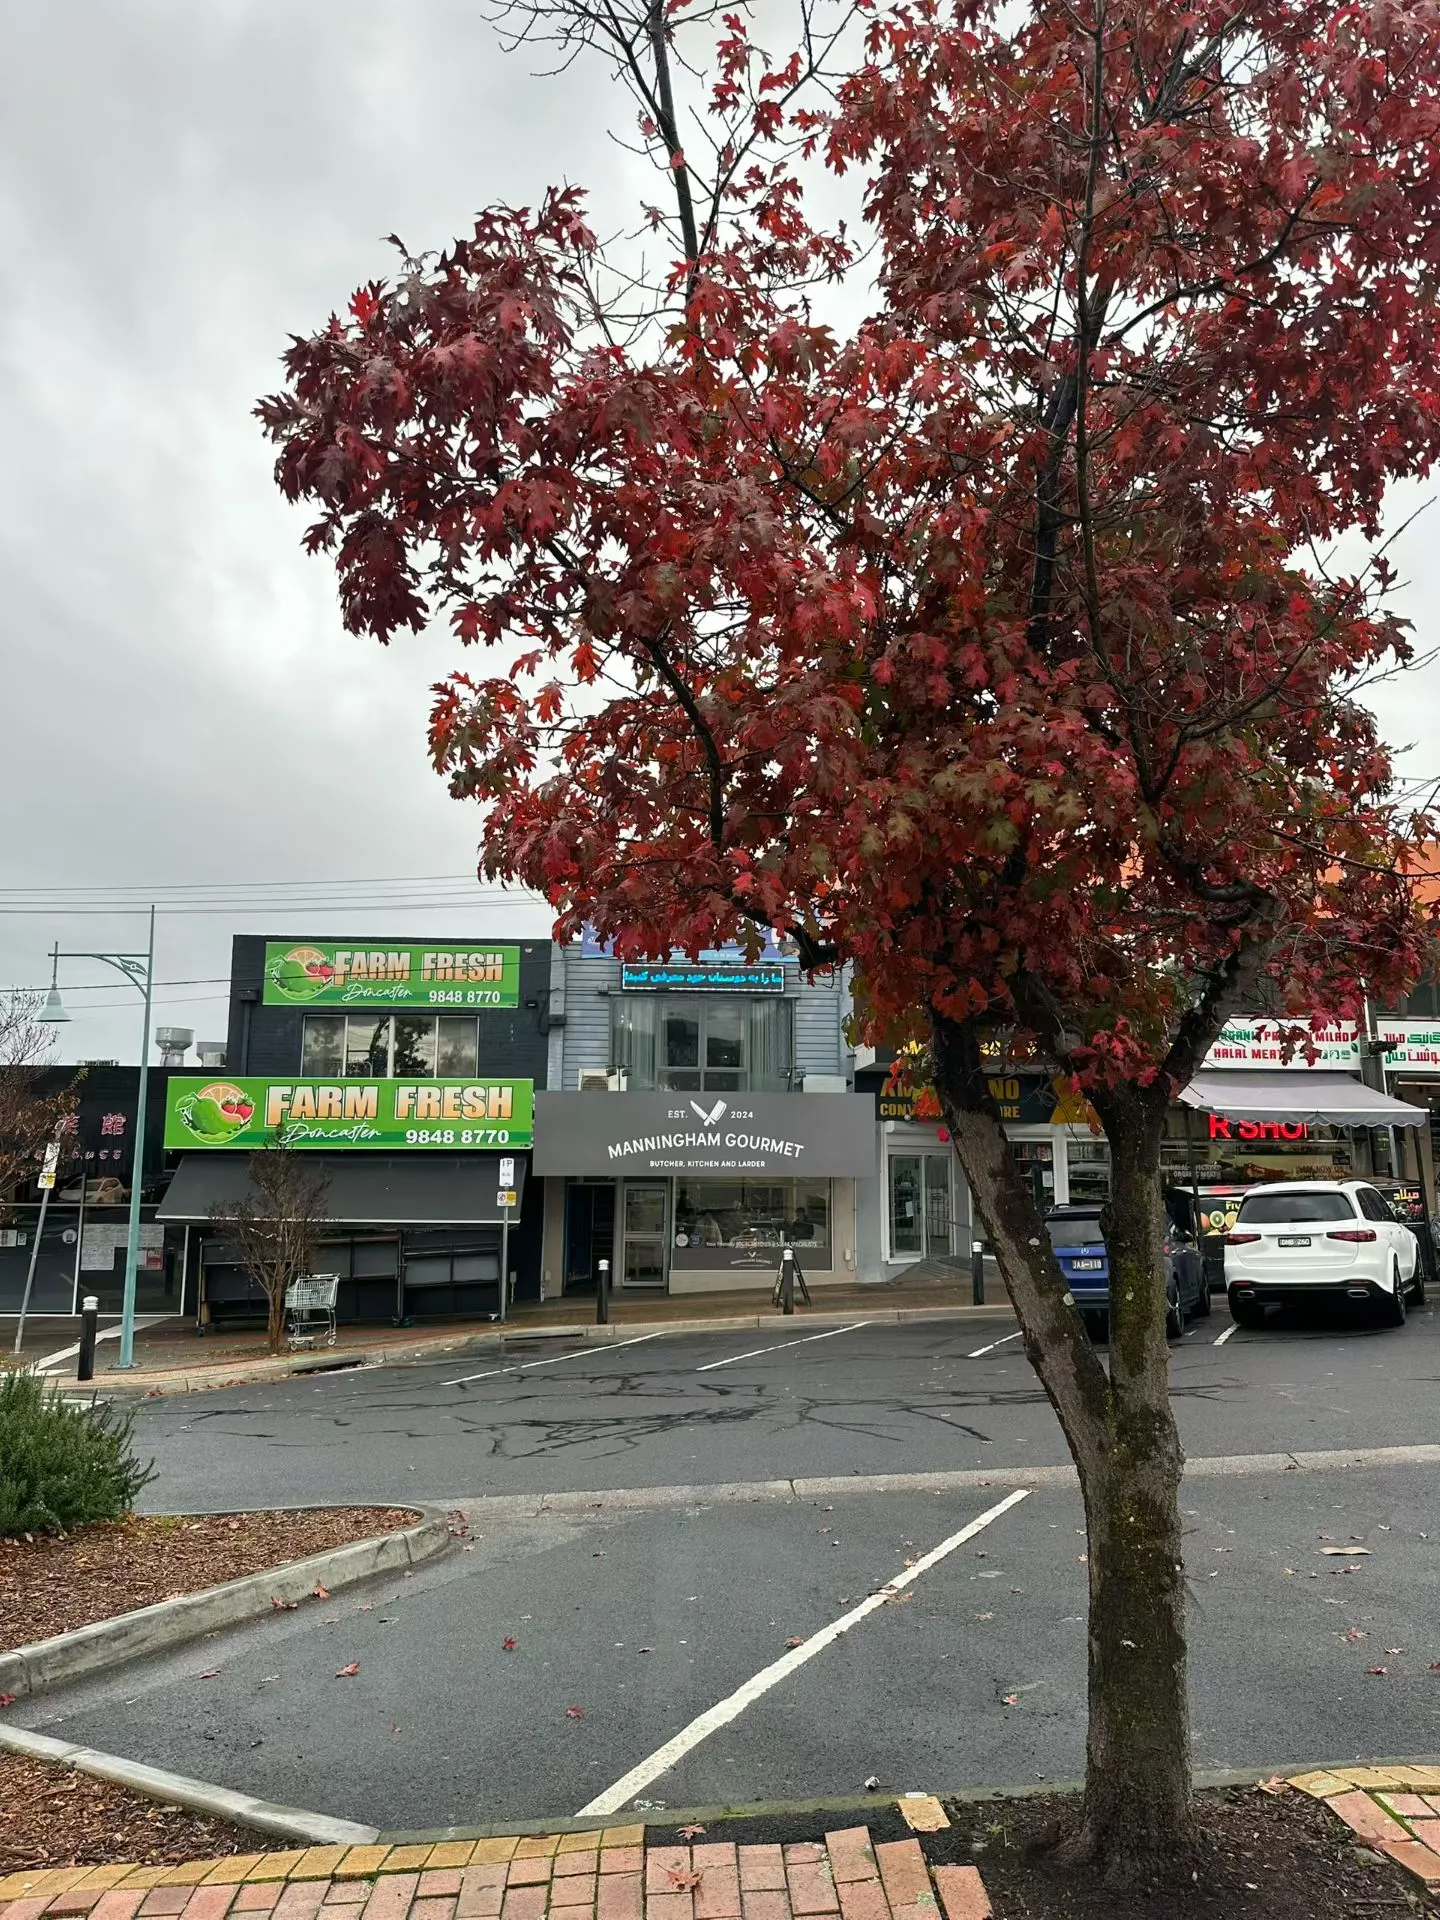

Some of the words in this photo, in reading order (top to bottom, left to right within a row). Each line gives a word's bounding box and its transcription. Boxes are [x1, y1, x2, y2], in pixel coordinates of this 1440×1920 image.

[332, 950, 412, 987] FARM
[421, 951, 504, 983] FRESH
[341, 983, 413, 1002] Doncaster
[429, 990, 463, 1003] 9848
[466, 991, 501, 1004] 8770
[1315, 1031, 1350, 1042] MILAD
[1214, 1048, 1248, 1059] HALAL
[264, 1085, 379, 1128] FARM
[395, 1085, 513, 1121] FRESH
[667, 1110, 688, 1119] EST.
[730, 1111, 754, 1119] 2024
[279, 1122, 382, 1144] Doncaster
[405, 1129, 455, 1144] 9848
[461, 1129, 510, 1144] 8770
[1239, 1119, 1308, 1140] SHO
[607, 1132, 721, 1159] MANNINGHAM
[725, 1133, 805, 1158] GOURMET
[649, 1160, 685, 1168] BUTCHER,
[687, 1160, 719, 1168] KITCHEN
[720, 1160, 737, 1168] AND
[738, 1160, 766, 1168] LARDER
